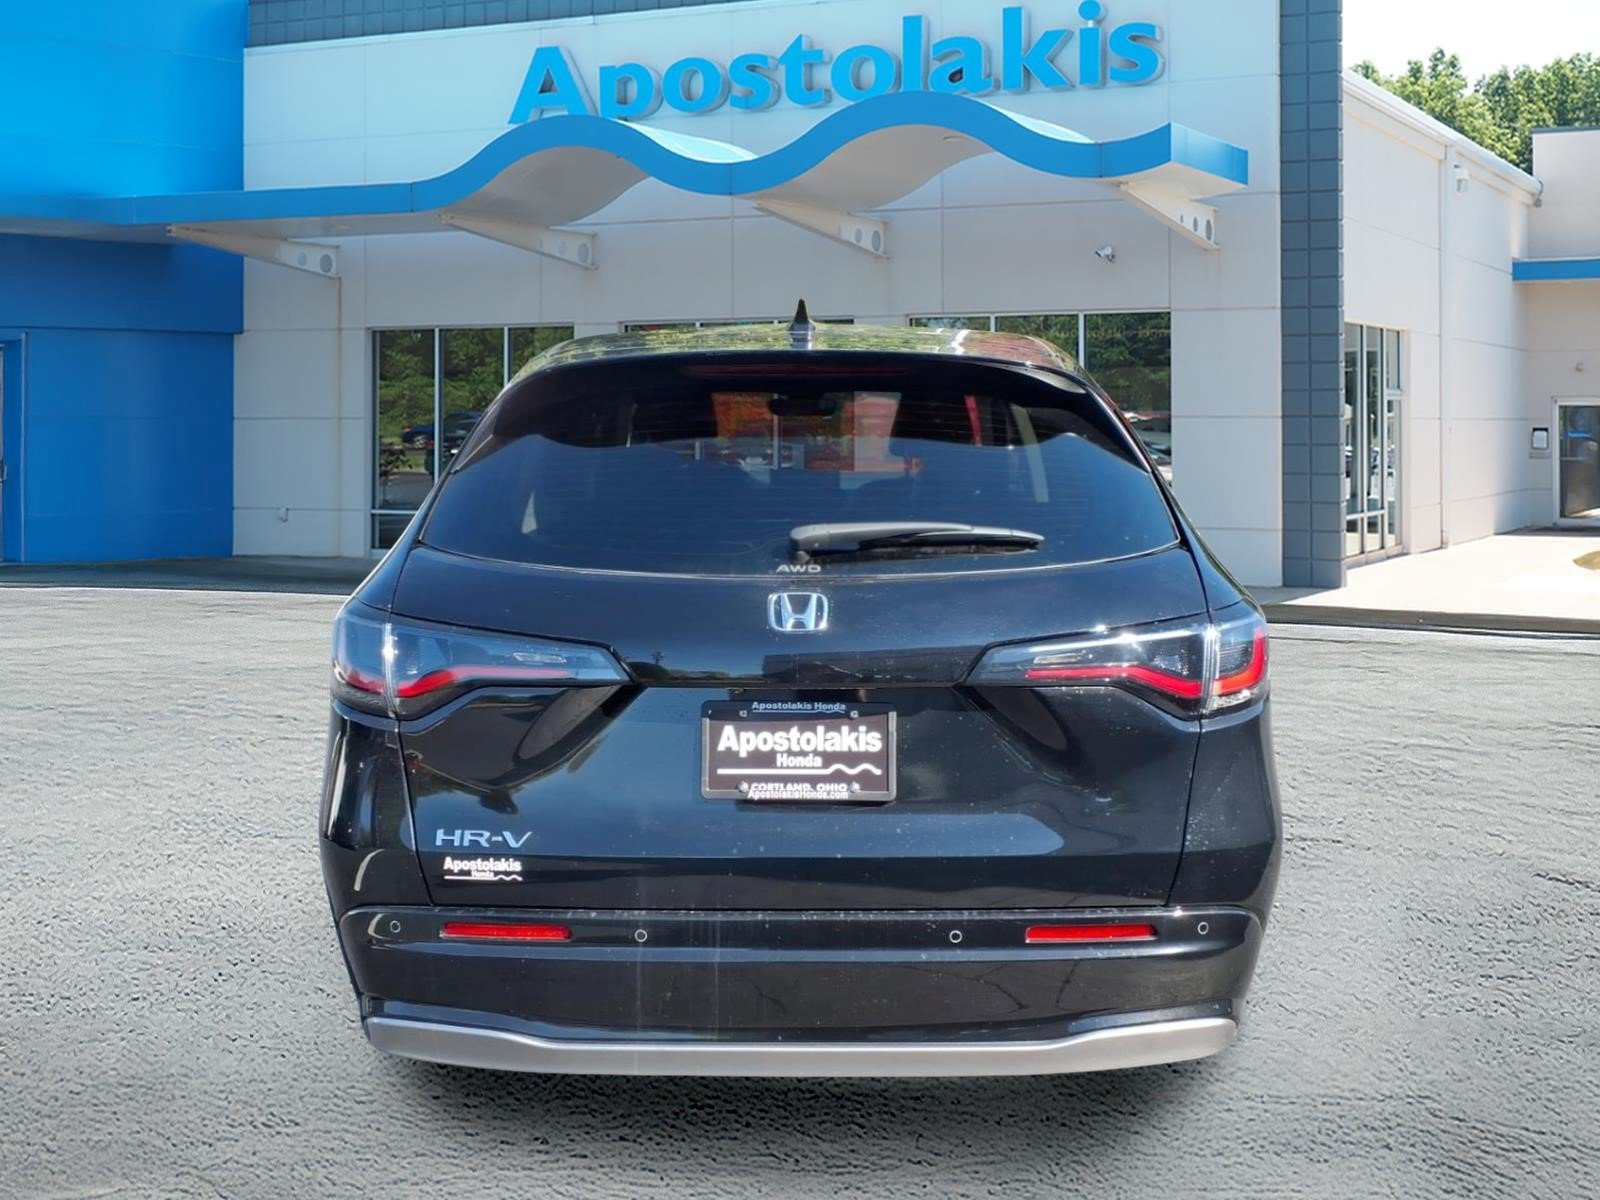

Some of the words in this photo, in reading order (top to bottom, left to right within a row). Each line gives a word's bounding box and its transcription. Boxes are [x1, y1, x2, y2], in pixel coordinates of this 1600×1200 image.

[507, 0, 1164, 124] Apostolakis
[776, 564, 821, 573] AWD
[751, 701, 812, 712] Apostolakis
[814, 702, 846, 711] Honda
[717, 724, 882, 758] Apostolakis
[776, 753, 823, 767] Honda
[816, 783, 848, 792] OHIO
[747, 790, 849, 800] ApostolakisHonda.com
[435, 828, 533, 849] HR-V
[443, 856, 522, 873] Apostolakis
